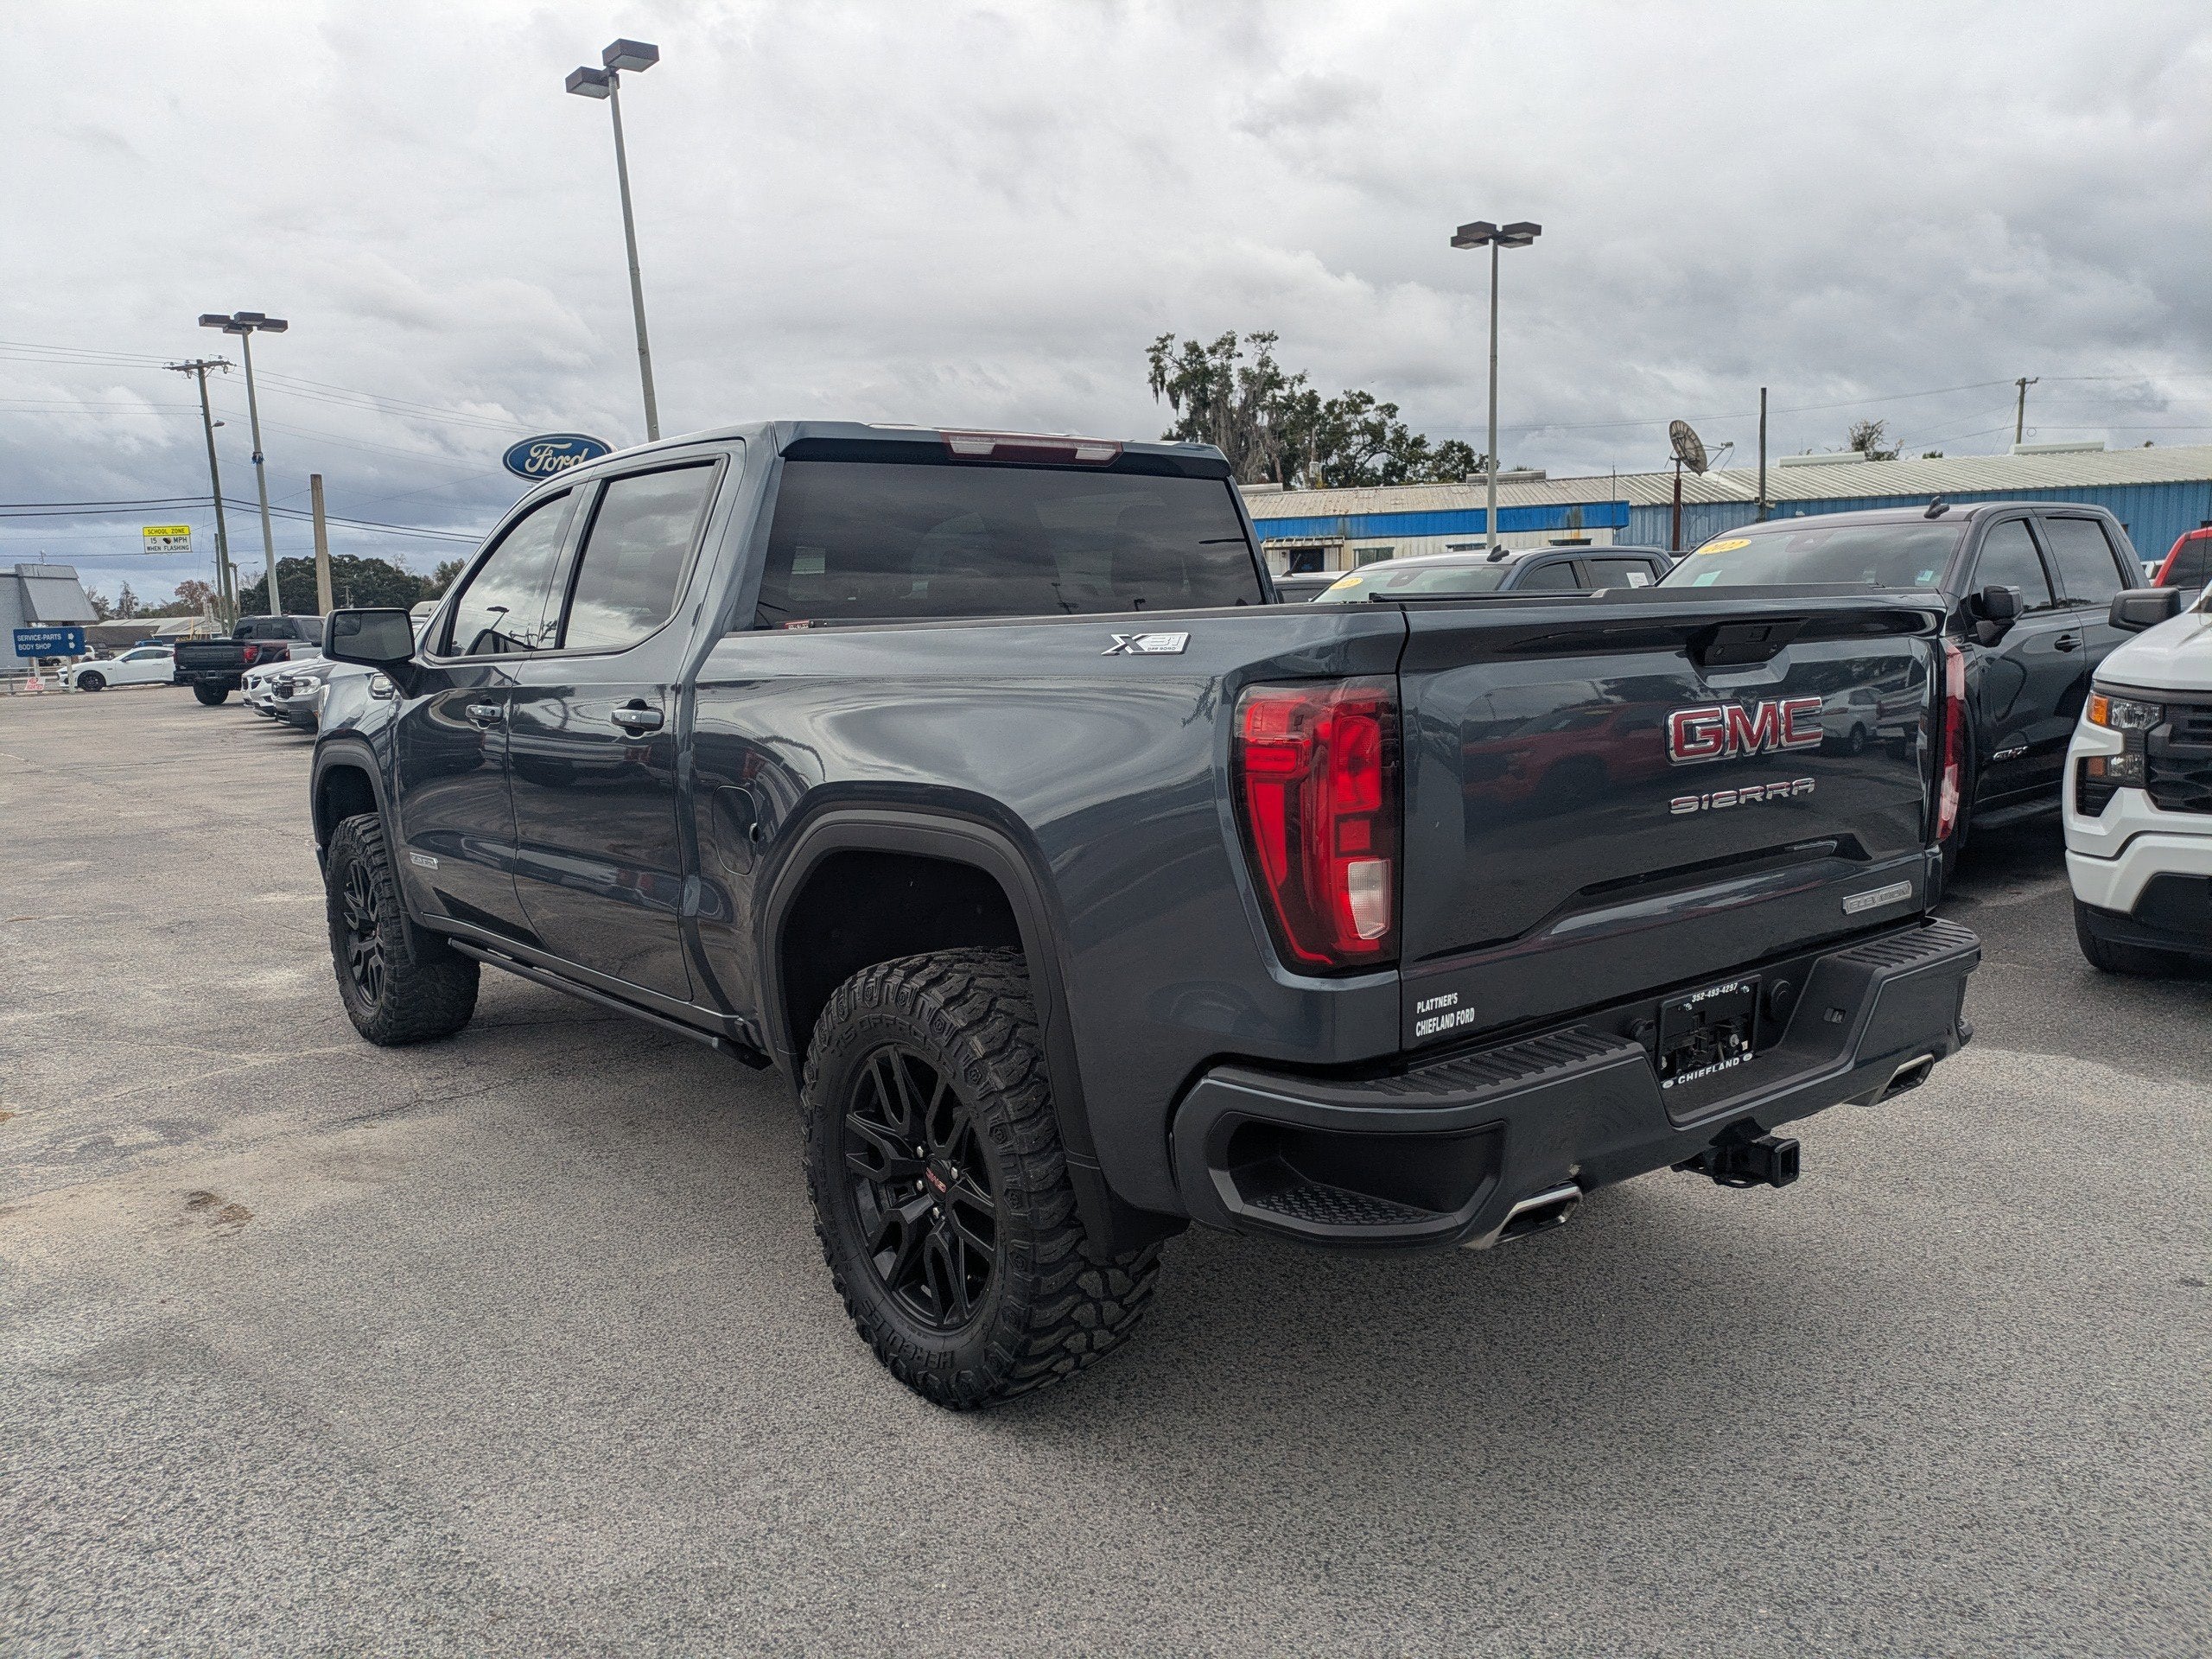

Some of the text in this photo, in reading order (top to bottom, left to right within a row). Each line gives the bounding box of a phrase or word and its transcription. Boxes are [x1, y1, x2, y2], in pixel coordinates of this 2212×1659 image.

[525, 442, 588, 473] Ford
[1668, 696, 1823, 763] GMC
[1669, 777, 1815, 815] SIERRA
[1417, 992, 1459, 1014] PLATTNER'S
[1415, 1007, 1475, 1037] CHIEFLAND FORD
[1677, 1057, 1740, 1084] CHIEFLAND
